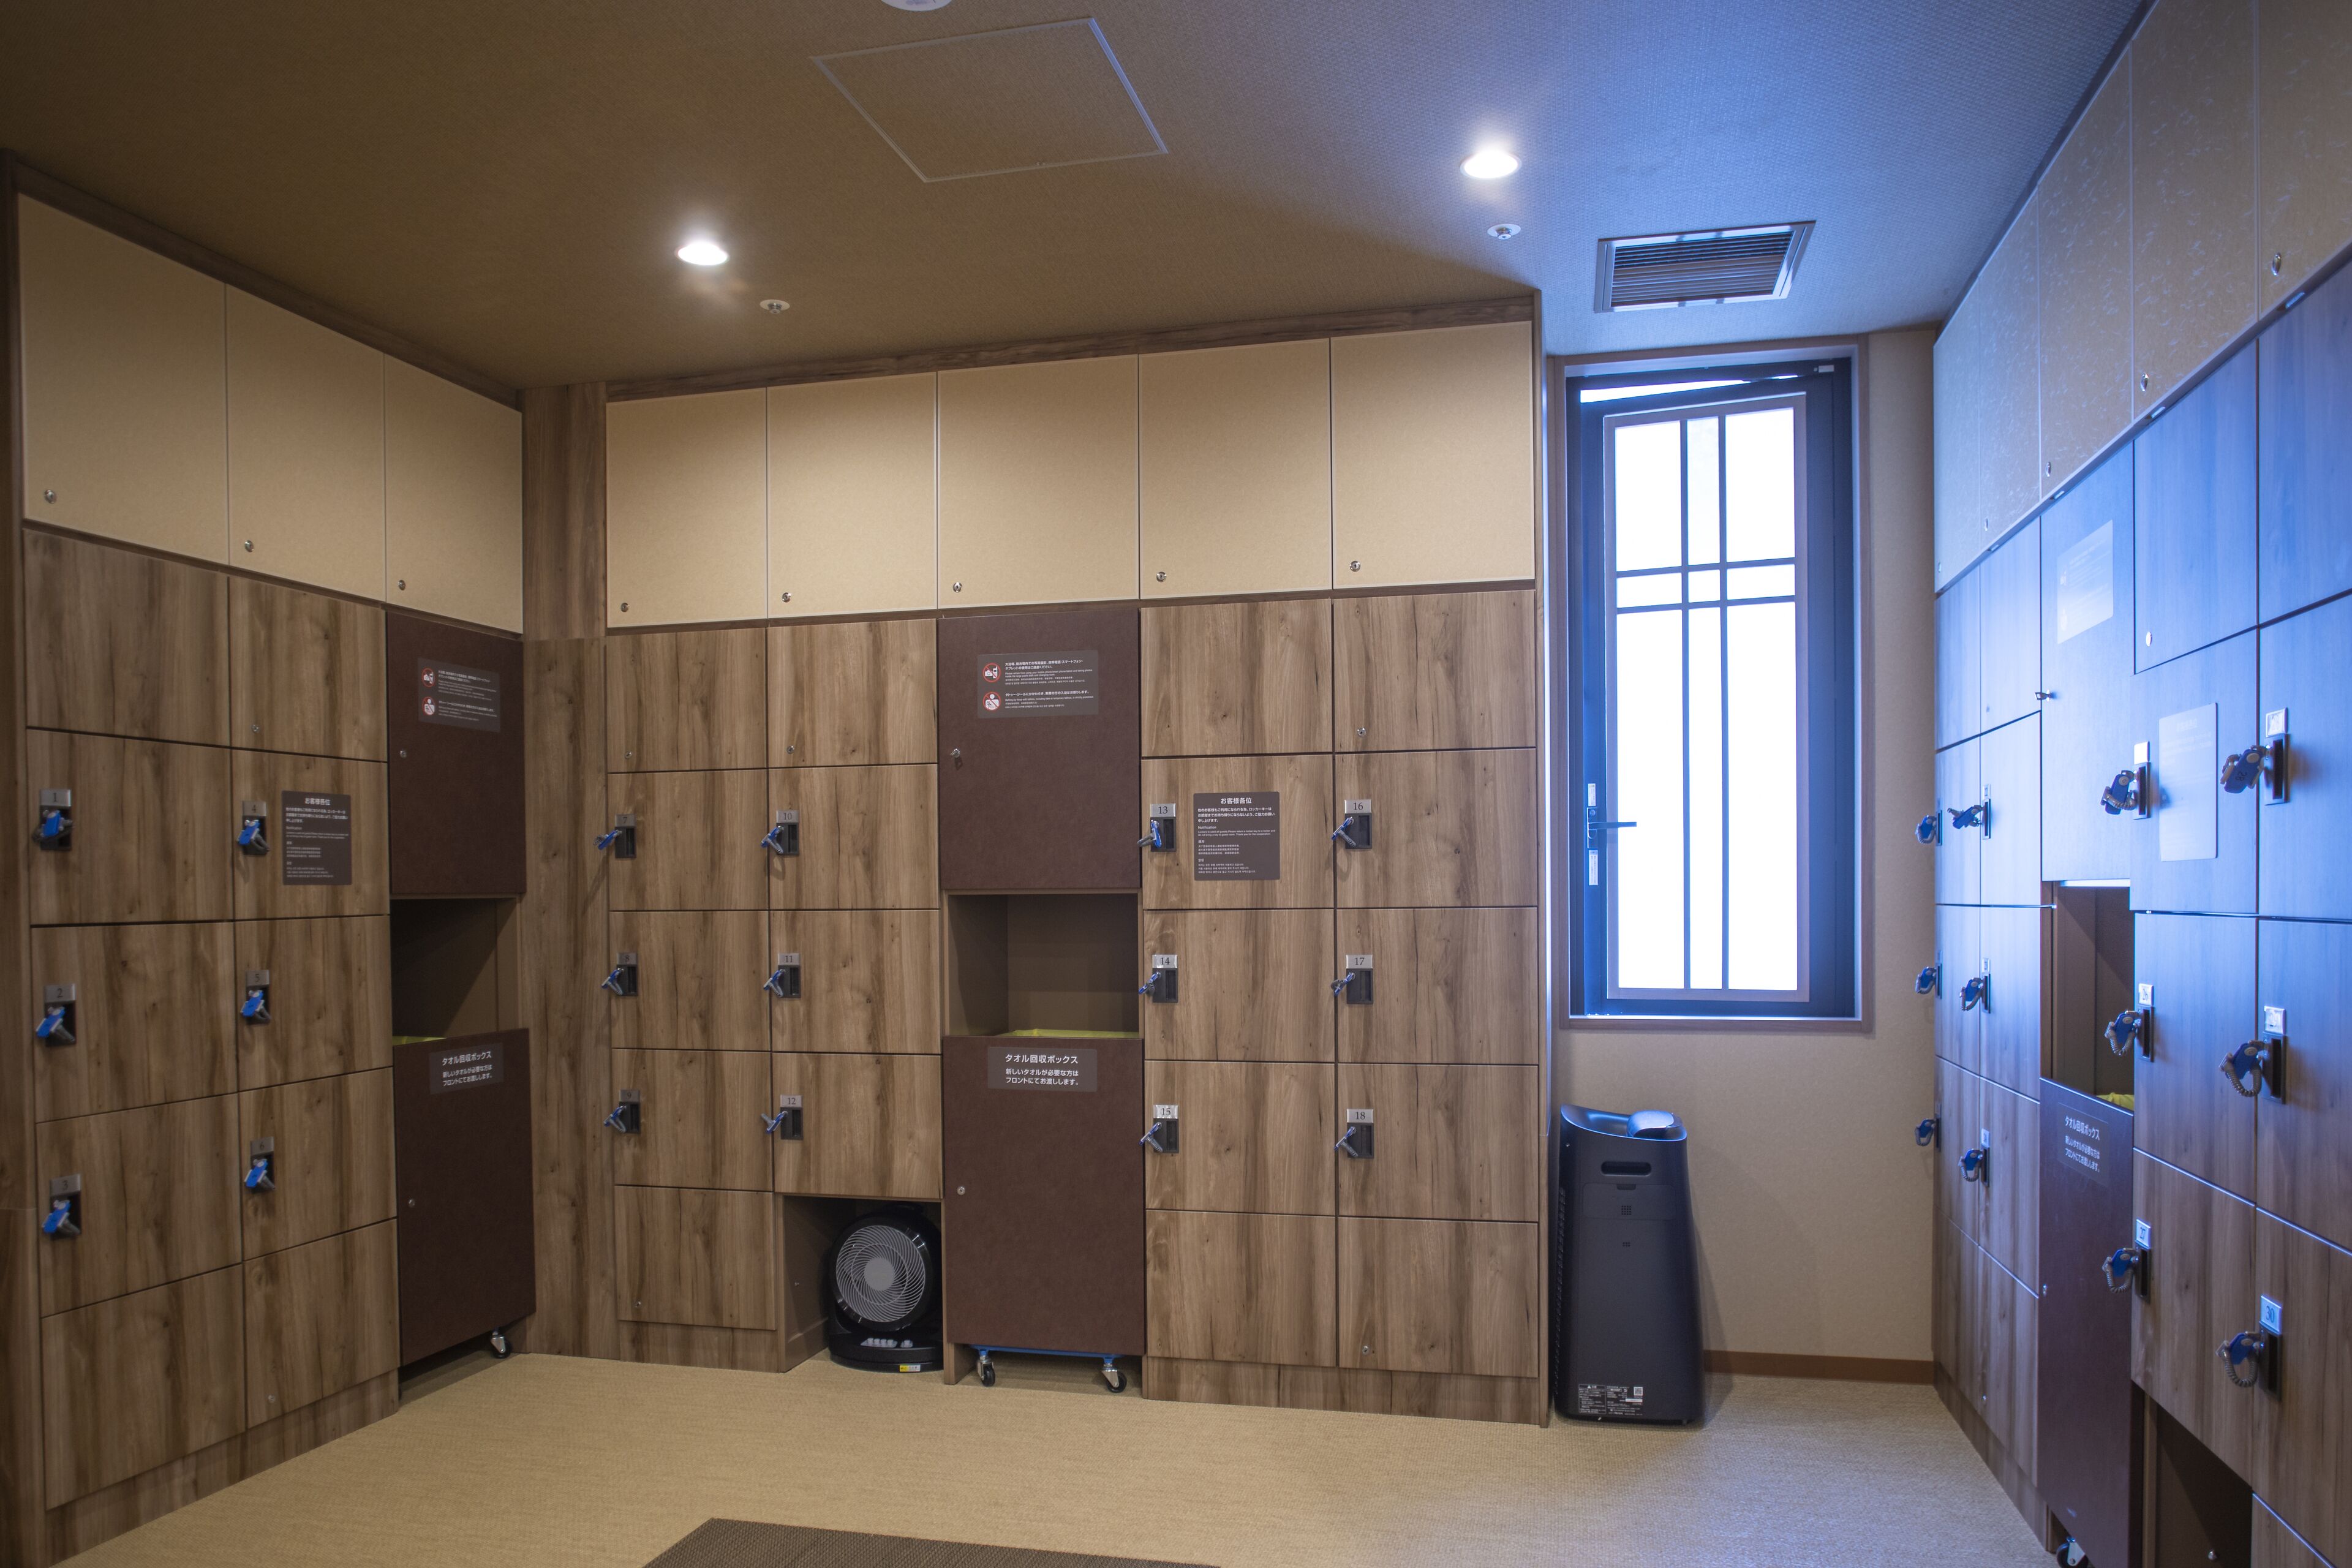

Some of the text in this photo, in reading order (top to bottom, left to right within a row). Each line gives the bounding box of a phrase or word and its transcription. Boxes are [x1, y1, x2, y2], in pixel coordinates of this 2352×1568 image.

[53, 793, 58, 802] 1
[251, 804, 257, 813] 4
[57, 988, 63, 998] 2
[442, 1051, 492, 1066] タオル回収ボックス
[1005, 1054, 1079, 1064] タオル回収ボックス
[442, 1065, 492, 1078] 新しいタオルが必要な方は
[1006, 1068, 1079, 1077] 新しいタオルが必要な方は
[1006, 1077, 1079, 1086] フロントにてお渡しします。
[2065, 1115, 2100, 1140] タオル回収ボックス
[260, 1141, 265, 1150] 6
[62, 1180, 68, 1191] 3
[2266, 1305, 2275, 1323] 30
